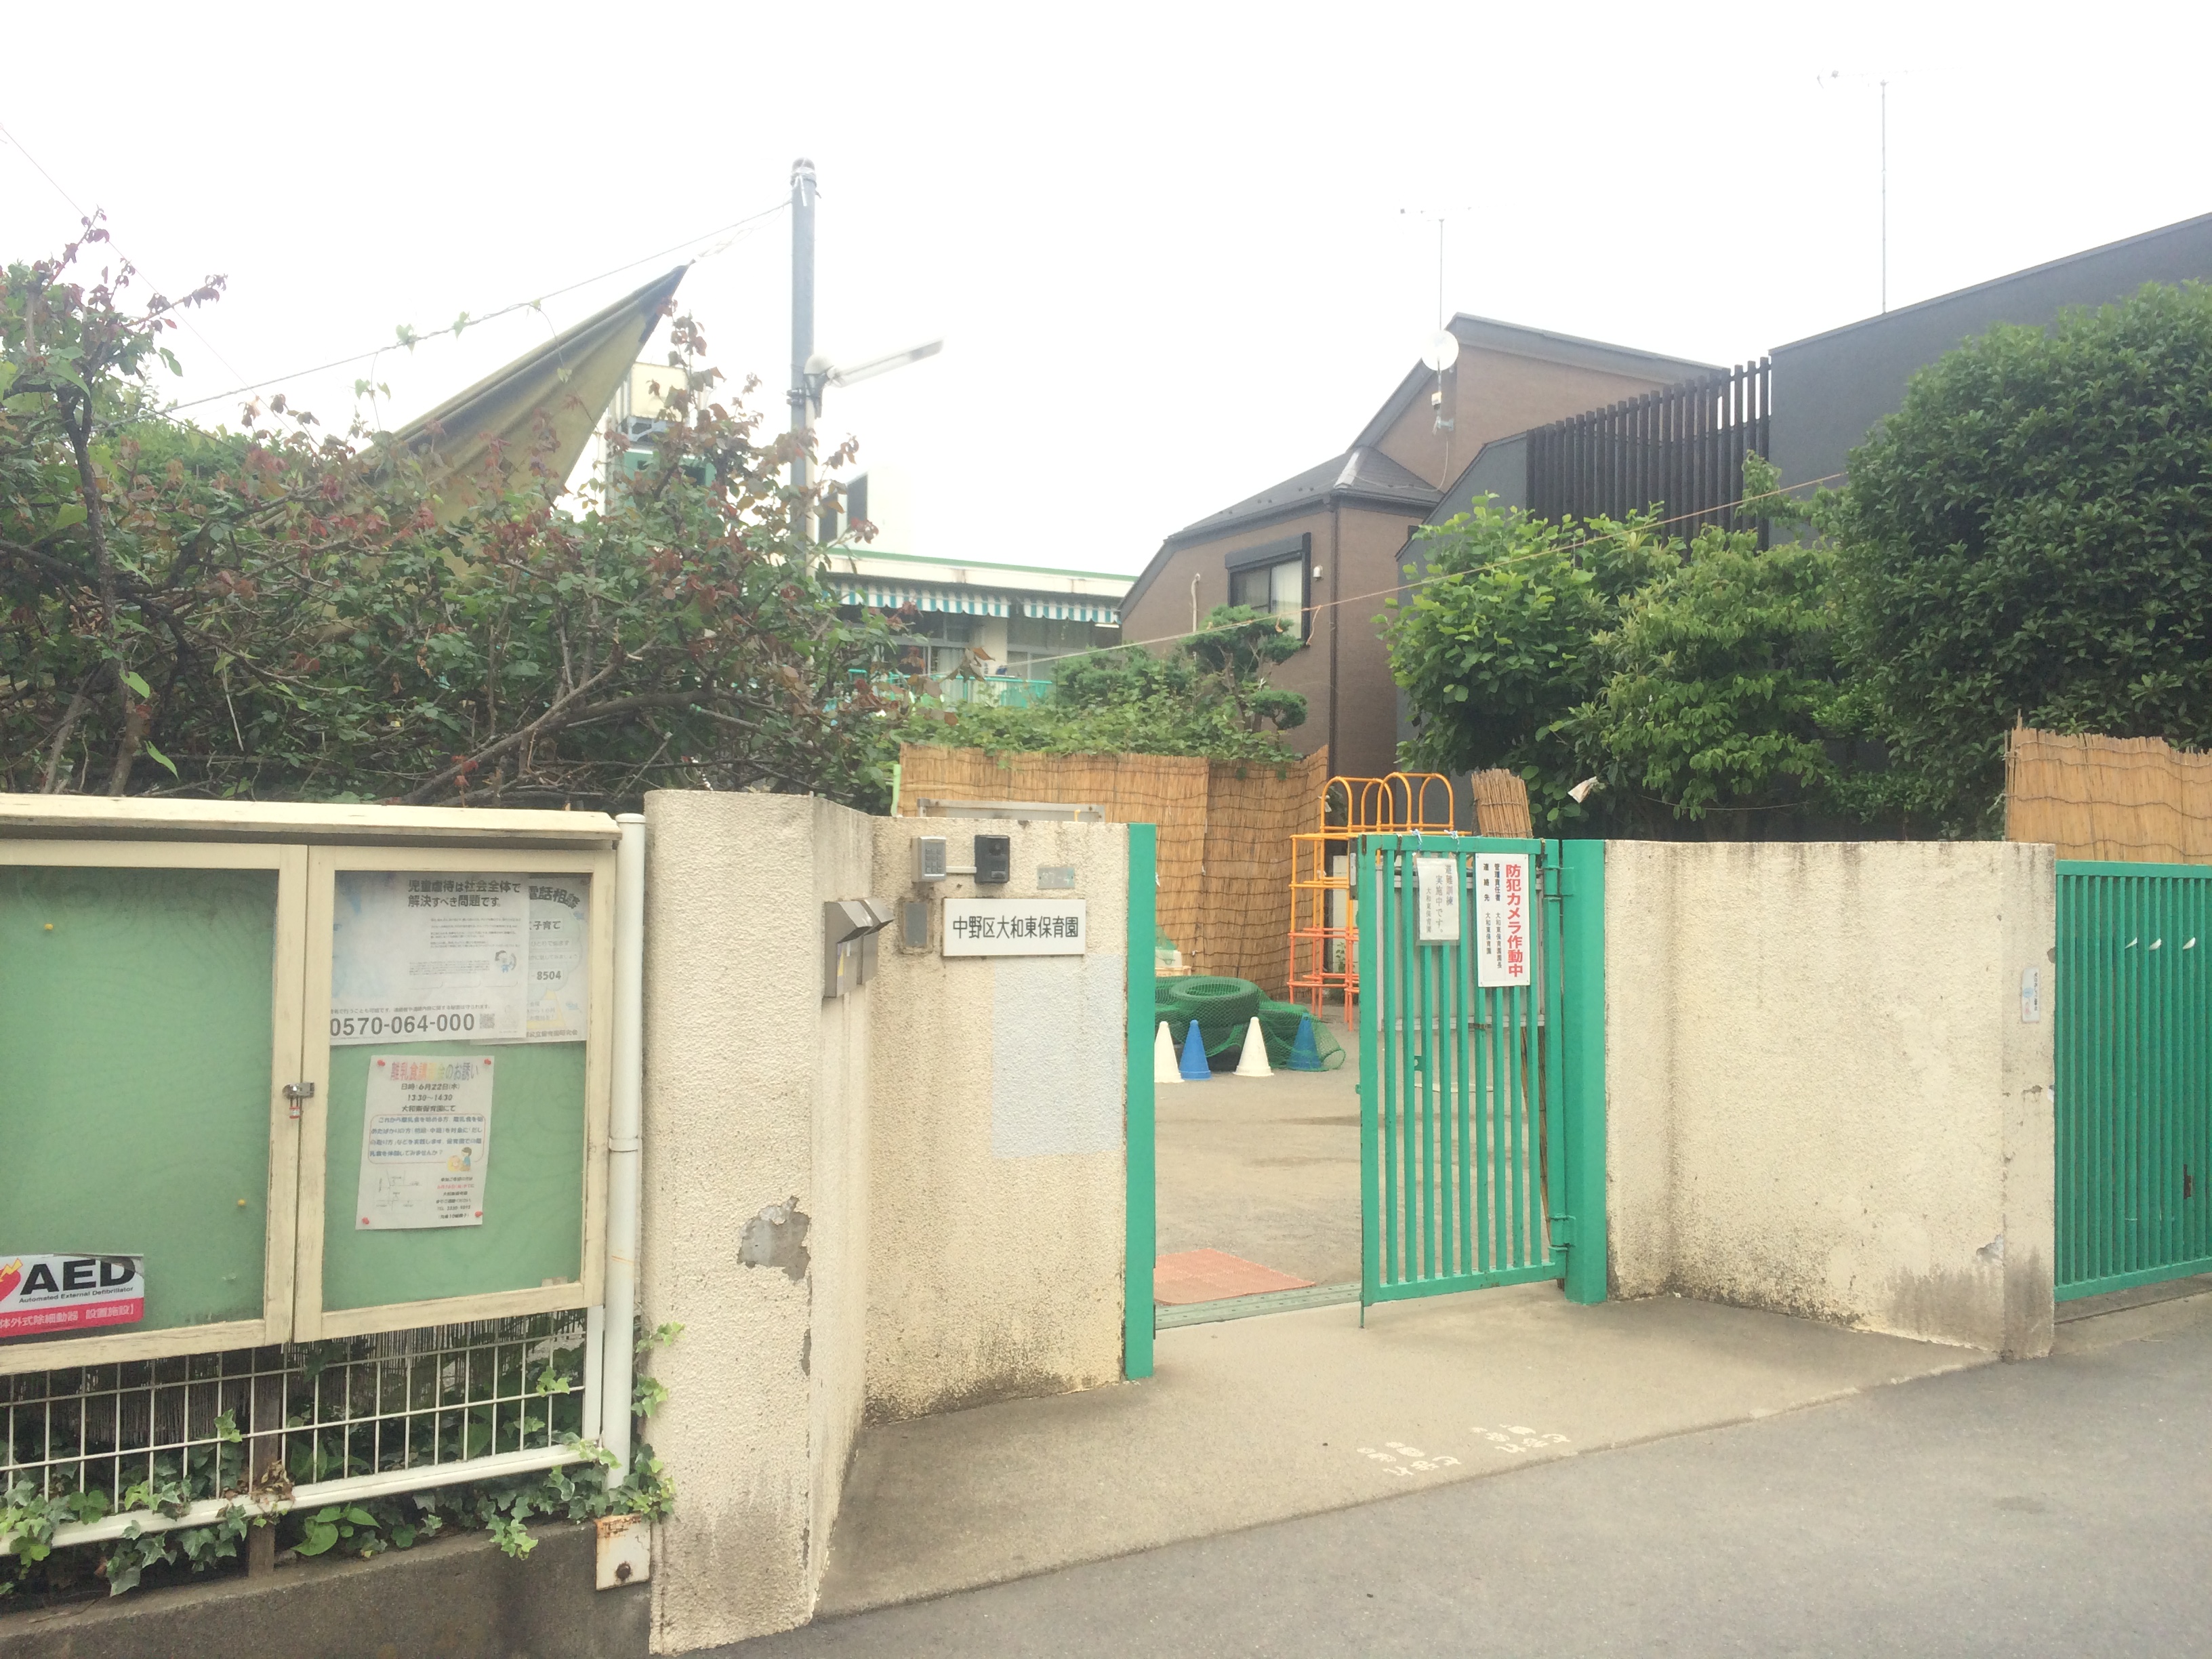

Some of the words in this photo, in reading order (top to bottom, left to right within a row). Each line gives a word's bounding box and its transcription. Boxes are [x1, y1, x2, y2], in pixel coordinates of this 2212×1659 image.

[408, 880, 520, 893] 児童虐待は社会全体で
[408, 895, 501, 907] 解決すべき問題です。
[952, 915, 1079, 939] 中野区大和東保育園
[1506, 864, 1523, 977] 防犯カメラ作動中
[330, 1013, 476, 1036] 0570-064-000
[20, 1258, 136, 1296] AED
[19, 1294, 59, 1303] Automated
[61, 1291, 91, 1299] External
[92, 1286, 134, 1295] Defibrillator
